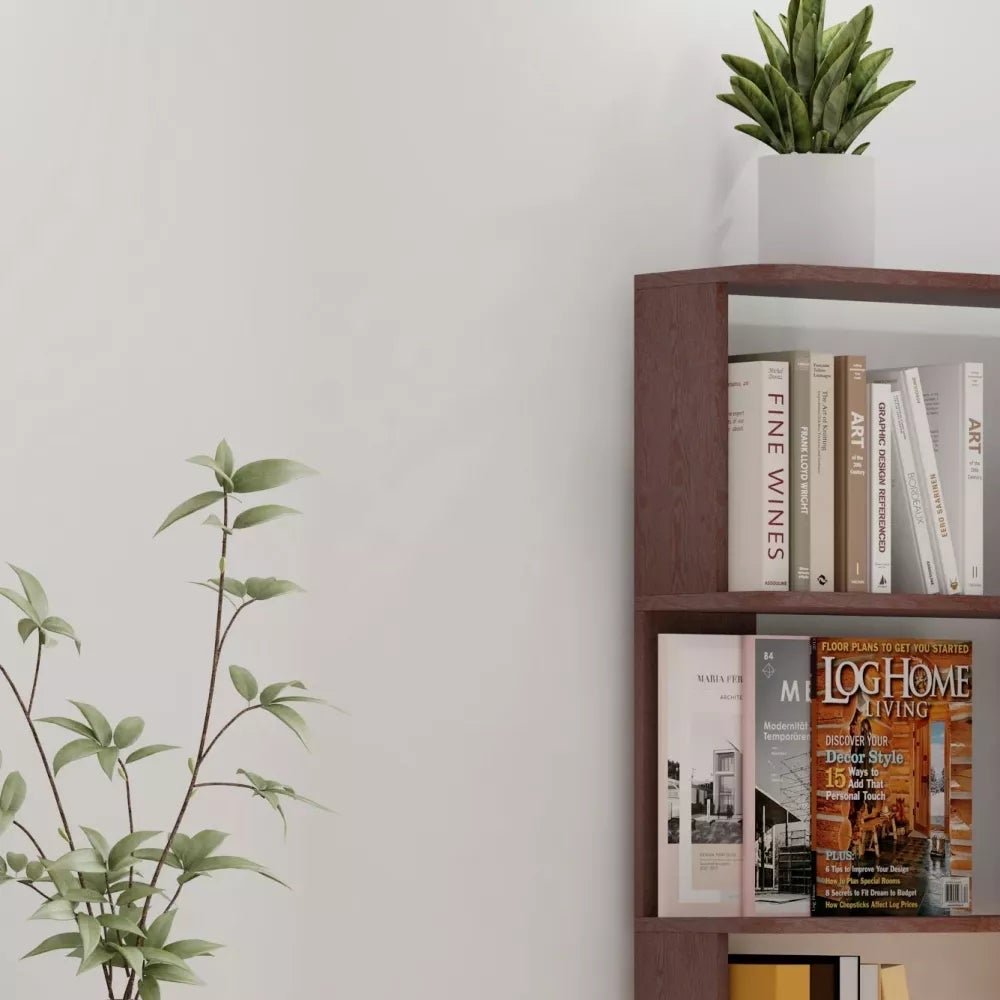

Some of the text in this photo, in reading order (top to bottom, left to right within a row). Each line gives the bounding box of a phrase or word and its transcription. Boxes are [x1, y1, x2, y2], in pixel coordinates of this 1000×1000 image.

[767, 393, 784, 455] FINE
[850, 410, 865, 449] ART
[968, 418, 982, 455] ART
[800, 426, 808, 515] FRANK LLOYD WRIGHT
[878, 402, 886, 553] GRAPHIC DESIGN REFERENCED
[907, 472, 924, 525] BORDEAUX
[930, 473, 948, 538] EERO SAARINEN
[767, 468, 784, 560] WINES
[822, 641, 849, 652] FLOOR
[851, 642, 879, 652] PLANS
[881, 643, 891, 652] TO
[895, 643, 910, 652] GET
[913, 643, 930, 653] YOU
[932, 644, 969, 654] STARTED
[697, 674, 725, 684] MARIA
[866, 700, 929, 718] LIVING
[825, 735, 888, 747] DISCOVER YOUR
[825, 749, 904, 768] Decor Style
[825, 766, 879, 788] 15 Ways to
[848, 778, 884, 789] Add That
[825, 790, 886, 801] Personal Touch
[825, 851, 854, 861] PLUS:
[890, 866, 910, 874] Design
[860, 877, 880, 885] Special
[831, 889, 852, 897] Secrets
[854, 889, 860, 897] to
[861, 889, 869, 897] Fit
[870, 889, 888, 897] Dream
[890, 889, 896, 897] to
[897, 889, 917, 898] Budget
[888, 901, 900, 910] Log
[900, 901, 918, 909] Prices
